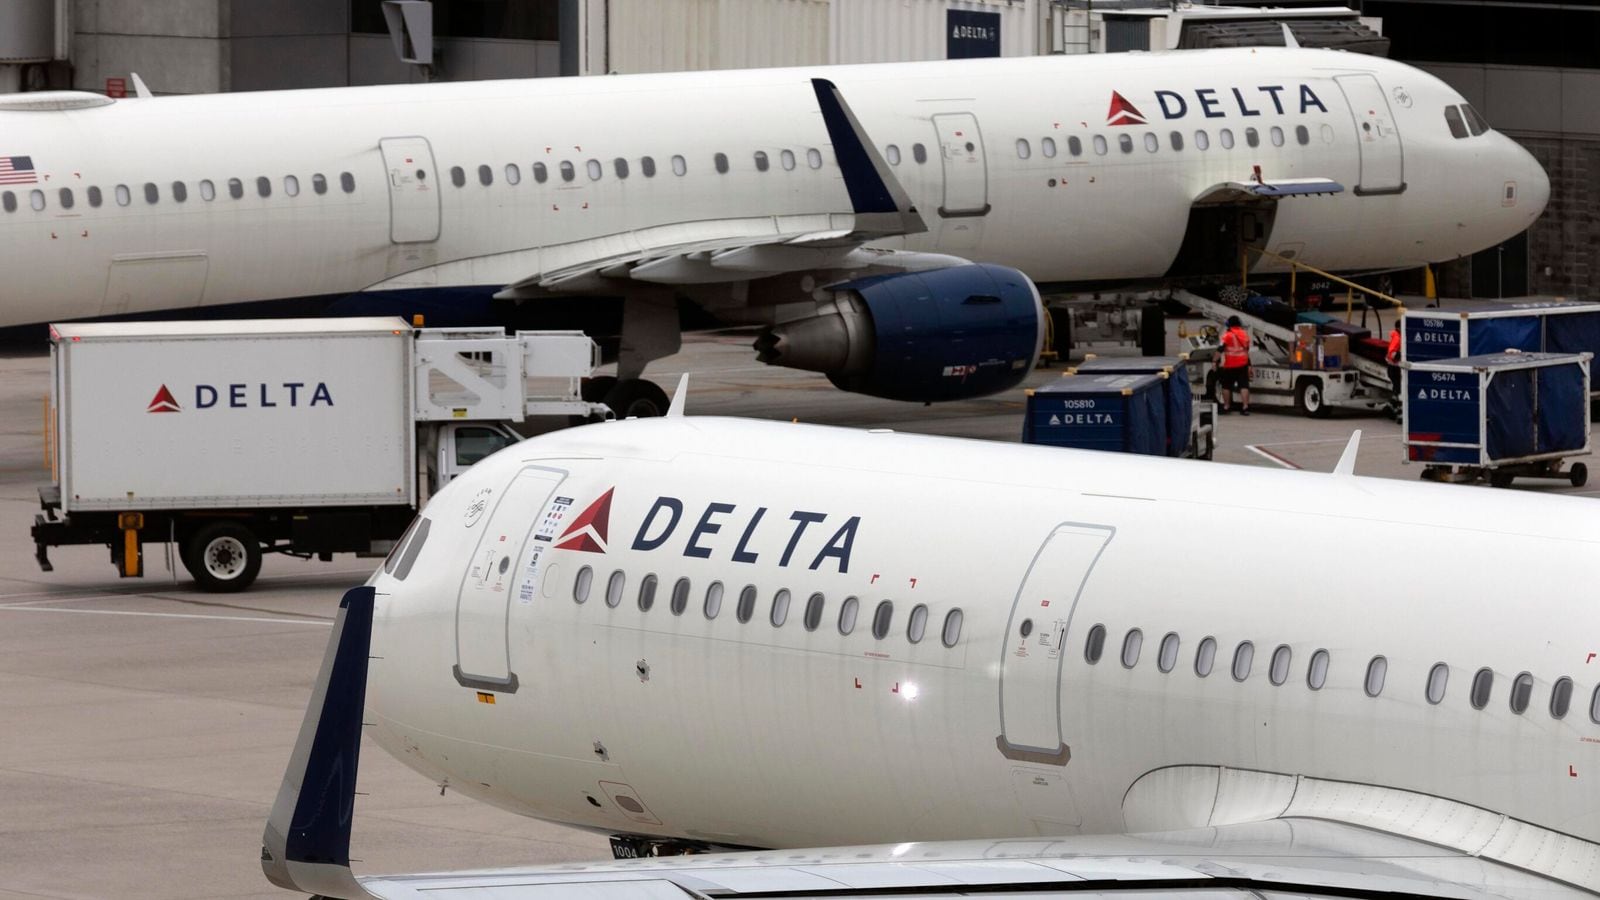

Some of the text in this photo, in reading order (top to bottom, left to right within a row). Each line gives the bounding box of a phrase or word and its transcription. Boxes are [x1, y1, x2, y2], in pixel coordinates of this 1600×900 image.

[960, 25, 988, 40] DELTA
[1153, 83, 1329, 120] DELTA
[1424, 332, 1456, 343] DELTA
[1255, 369, 1281, 380] DELTA
[1431, 372, 1456, 382] 95474
[195, 382, 334, 409] DELTA
[1431, 388, 1471, 400] DELTA
[1064, 399, 1096, 409] 105810
[1064, 413, 1114, 424] DELTA
[631, 495, 862, 574] DELTA
[613, 844, 638, 858] 1004
